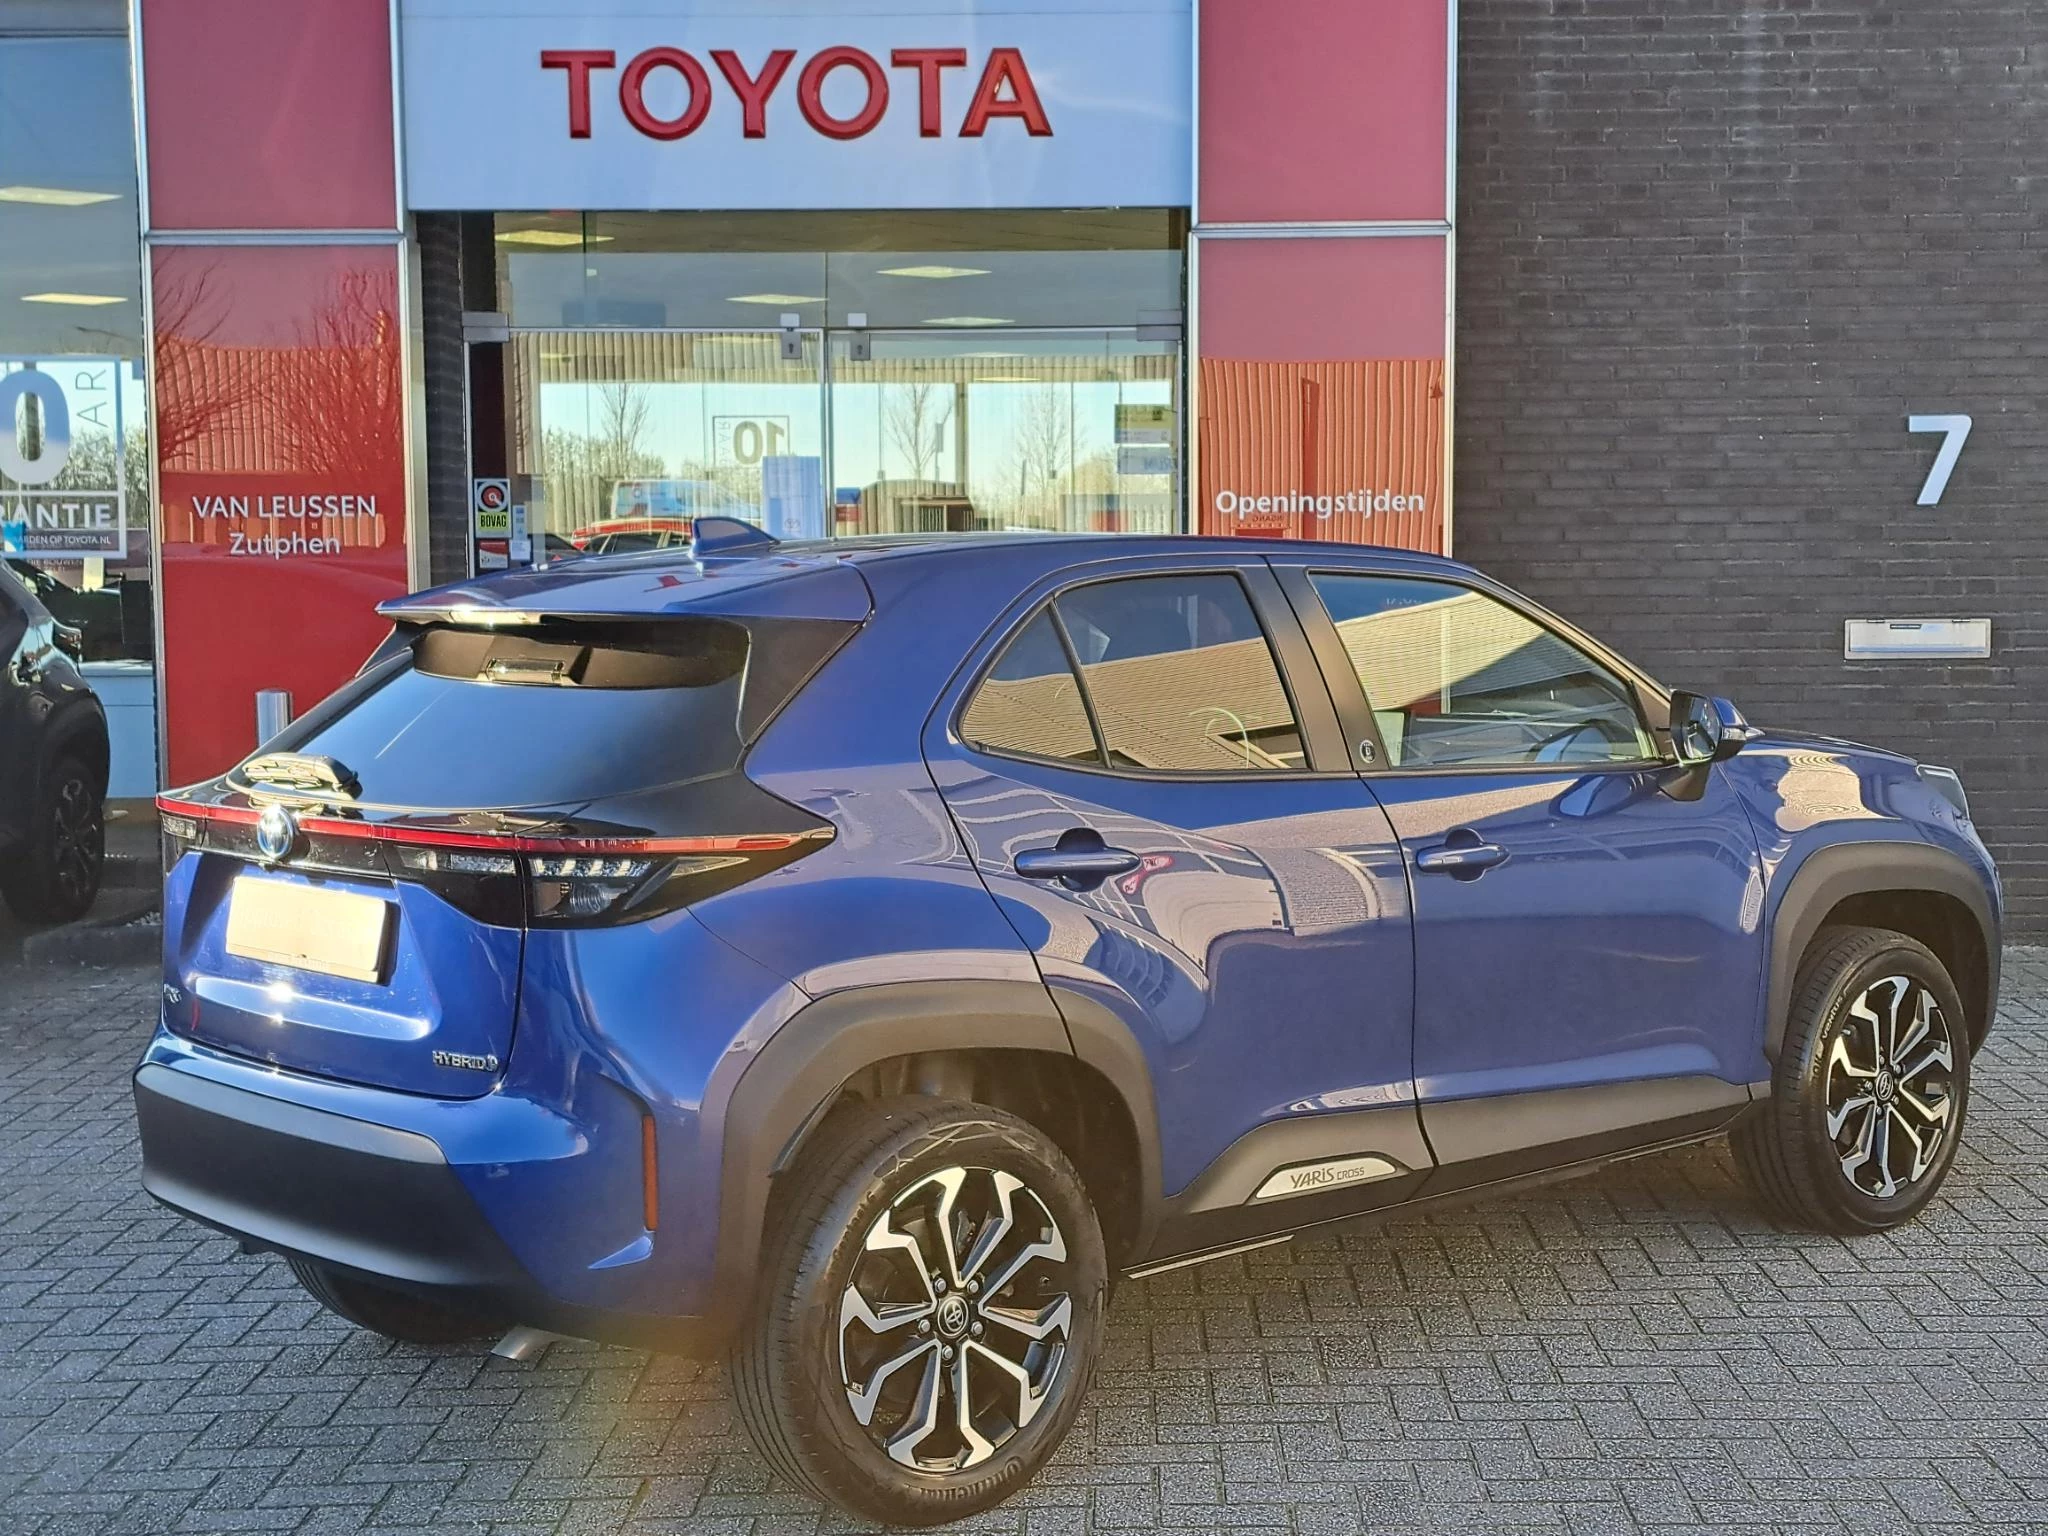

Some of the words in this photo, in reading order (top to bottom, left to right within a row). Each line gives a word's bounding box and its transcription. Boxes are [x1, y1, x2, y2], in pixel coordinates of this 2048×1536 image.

[541, 46, 1054, 140] TOYOTA
[1908, 415, 1973, 505] 7
[0, 502, 112, 529] ANTIE
[192, 496, 249, 518] VAN
[257, 495, 376, 518] LEUSSEN
[1216, 489, 1425, 520] Openingstijden
[480, 514, 507, 528] BOVAG
[64, 535, 111, 545] TOYOTA.NL
[229, 531, 340, 560] Zutphen
[432, 1051, 486, 1070] HYBRID
[1337, 1167, 1365, 1181] CROSS
